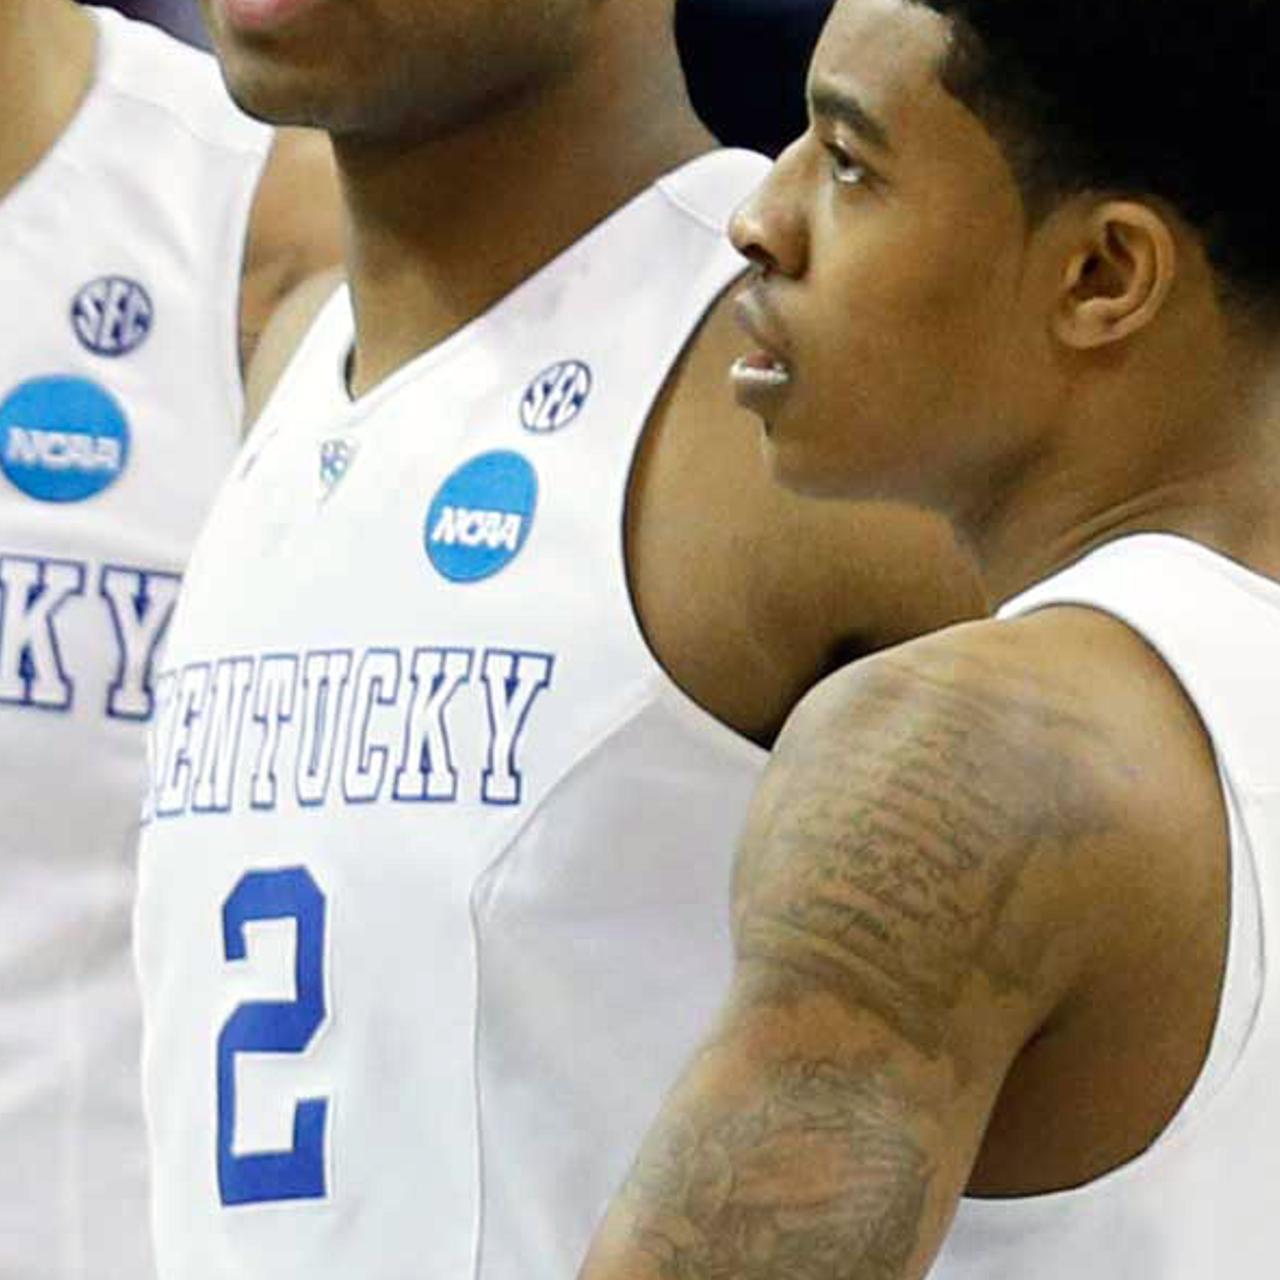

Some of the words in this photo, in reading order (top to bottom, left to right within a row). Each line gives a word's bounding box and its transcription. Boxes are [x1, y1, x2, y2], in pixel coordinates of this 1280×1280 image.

[72, 276, 152, 356] SEC
[521, 360, 591, 433] SEC
[8, 426, 120, 471] NCAA
[432, 506, 522, 551] NCAA
[216, 865, 328, 1206] 2
